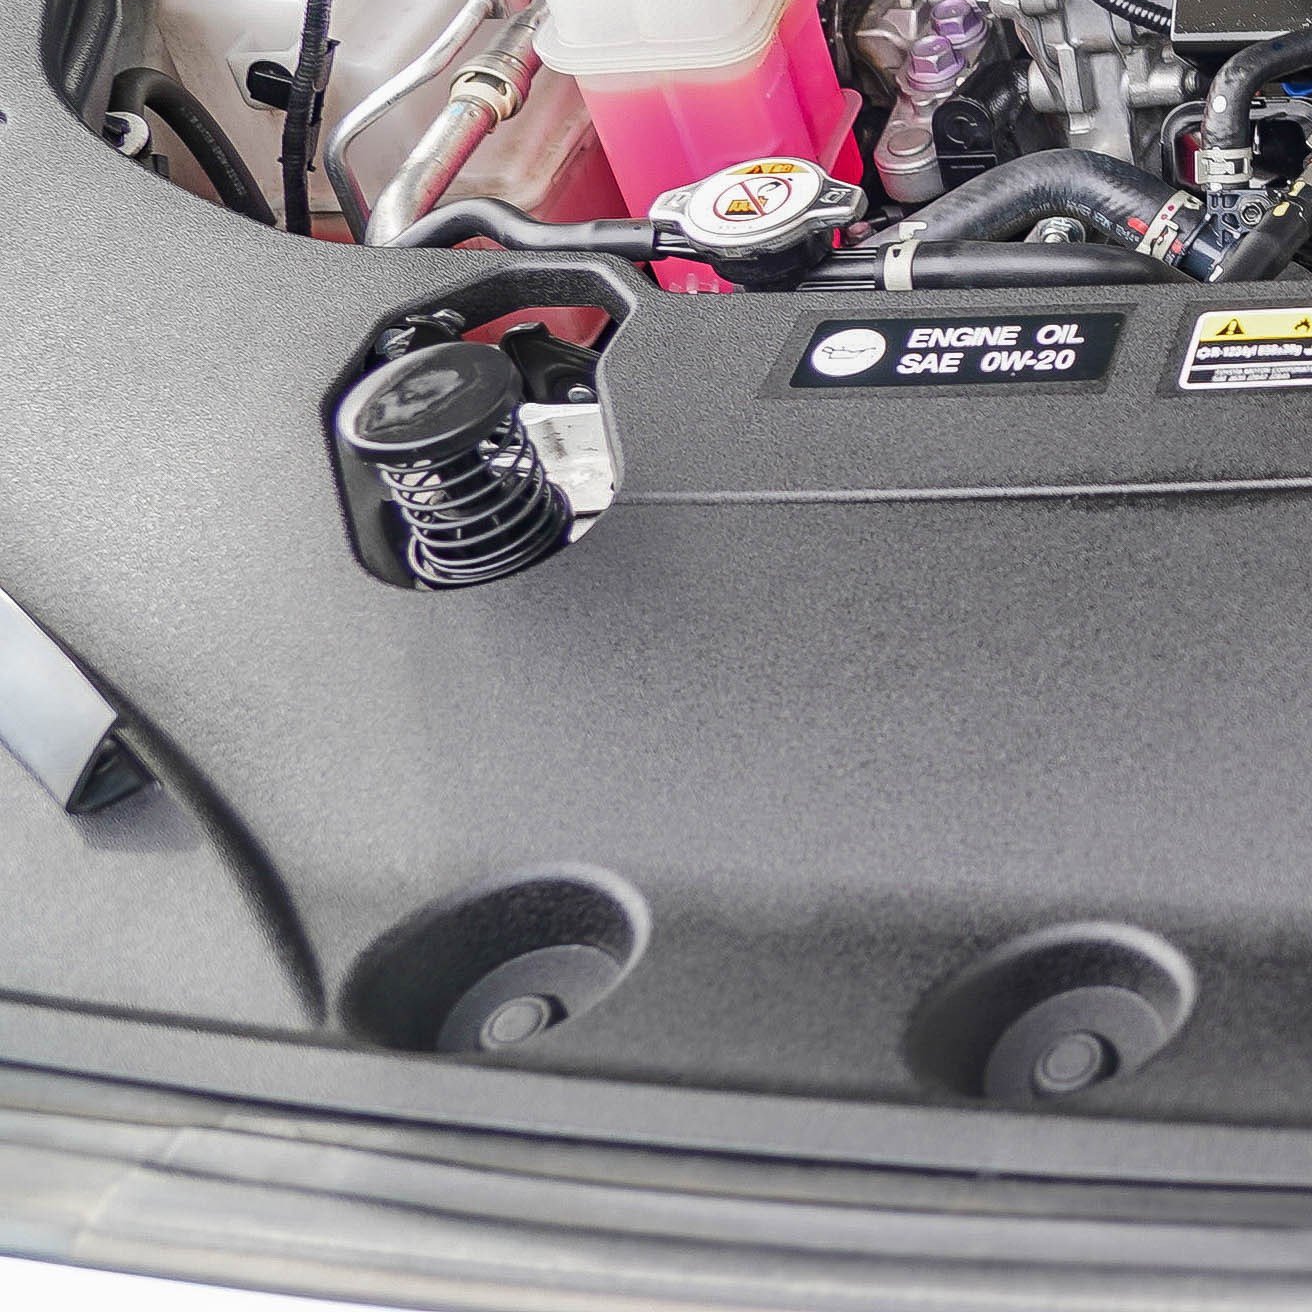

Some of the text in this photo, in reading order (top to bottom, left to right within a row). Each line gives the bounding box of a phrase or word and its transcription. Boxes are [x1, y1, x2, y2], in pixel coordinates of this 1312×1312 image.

[907, 323, 1085, 349] ENGINE OIL
[896, 348, 1077, 374] SAE 0W-20
